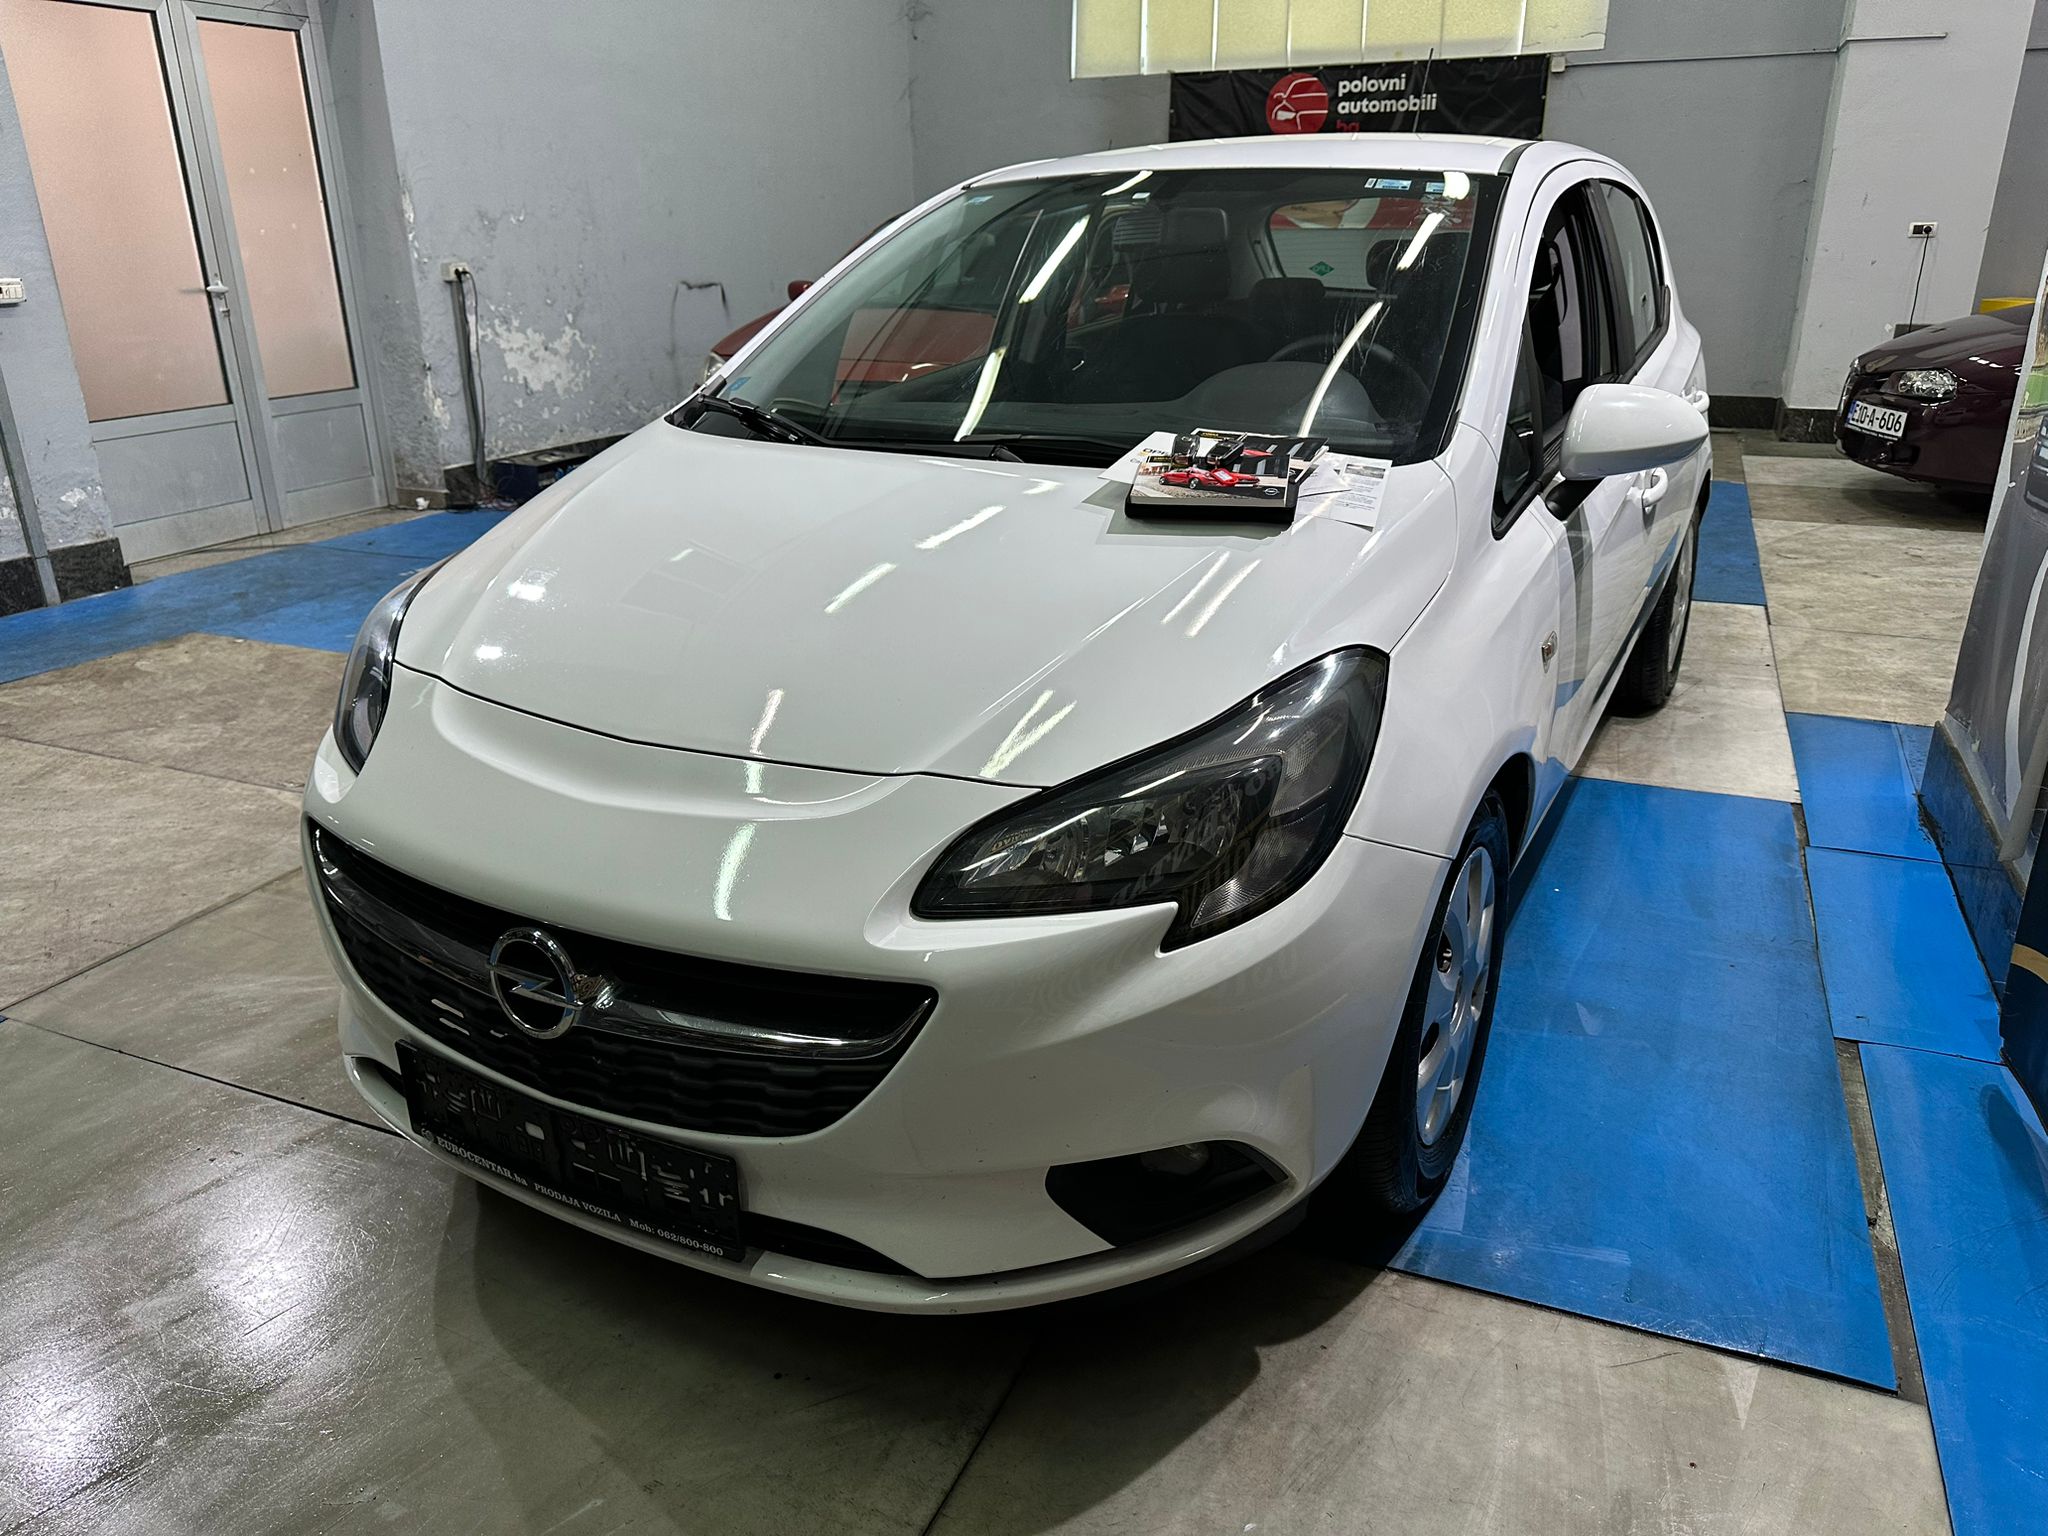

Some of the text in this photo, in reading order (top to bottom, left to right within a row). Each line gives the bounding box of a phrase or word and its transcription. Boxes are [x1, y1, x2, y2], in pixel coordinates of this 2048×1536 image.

[1338, 73, 1406, 97] polovni
[1337, 93, 1437, 114] automobili
[436, 1136, 724, 1257] EUROCENTAR.ba PRODAJA VOZILA Mob: 062/800-800
